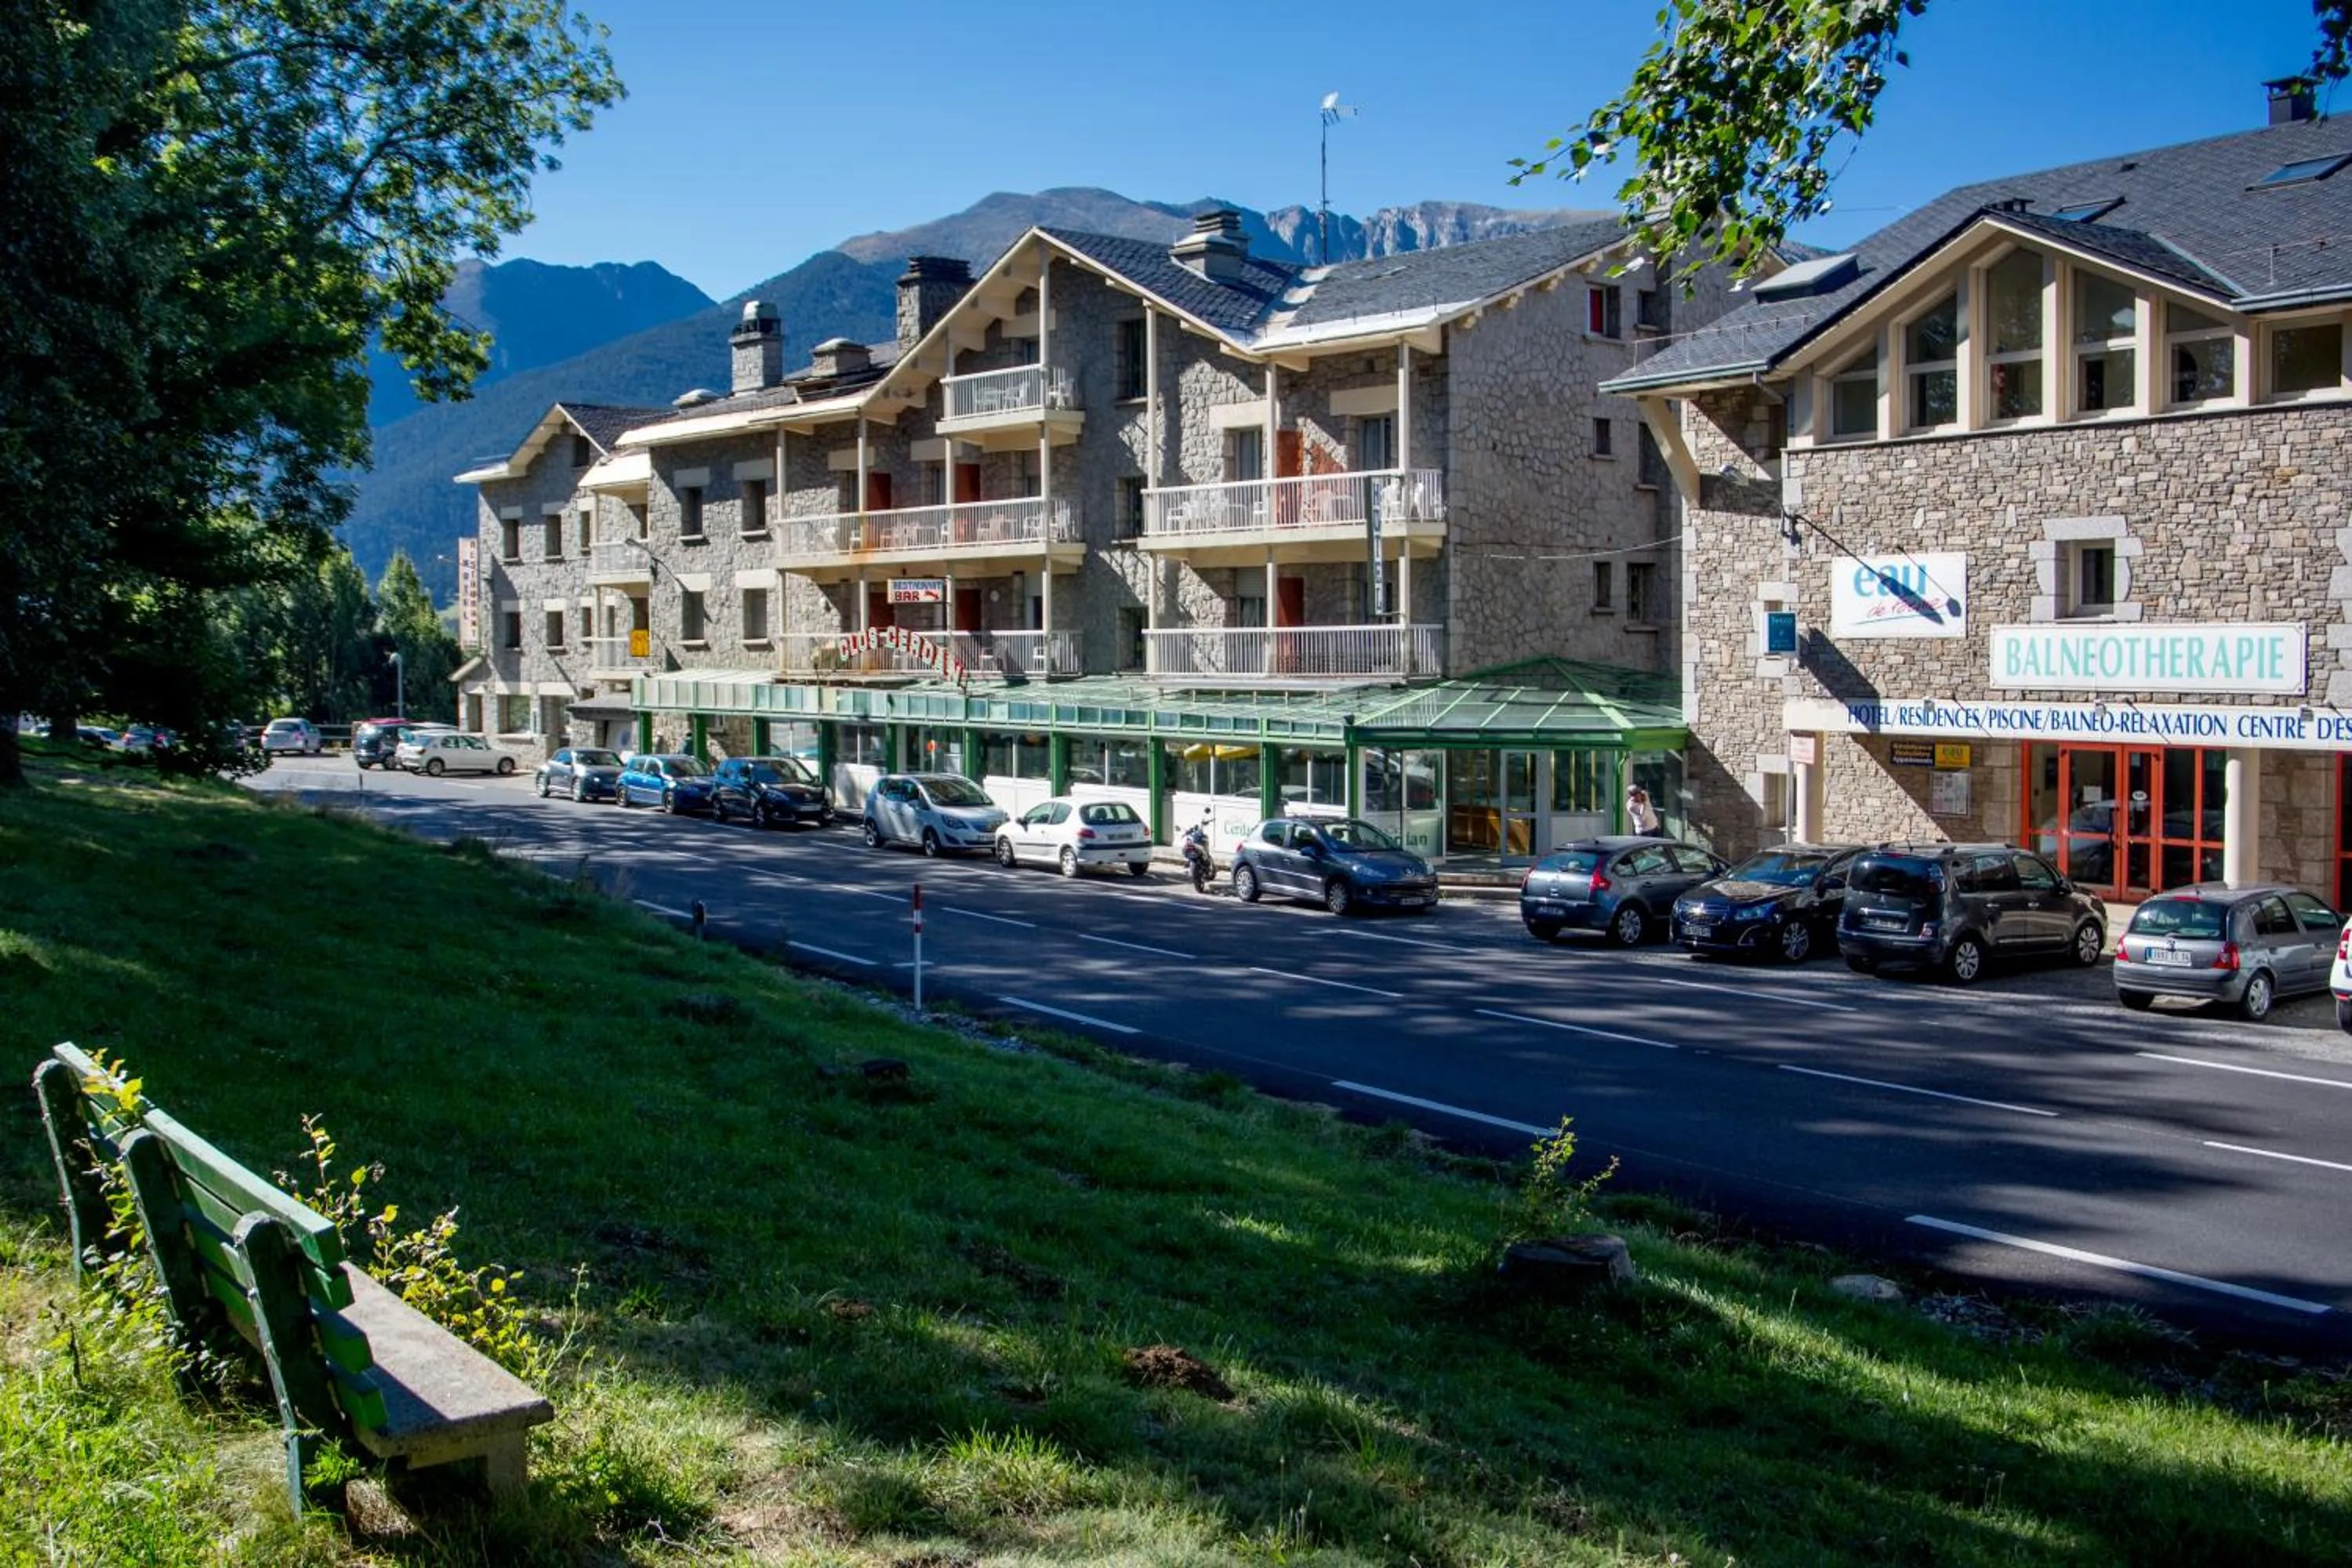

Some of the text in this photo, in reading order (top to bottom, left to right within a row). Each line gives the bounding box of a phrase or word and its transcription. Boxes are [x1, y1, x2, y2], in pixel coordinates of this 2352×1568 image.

[1373, 482, 1382, 610] HOTEL
[895, 591, 920, 601] BAR
[1853, 561, 1926, 597] eau
[2005, 636, 2285, 680] BALNEOTHERAPIE
[2238, 714, 2306, 739] CENTRE
